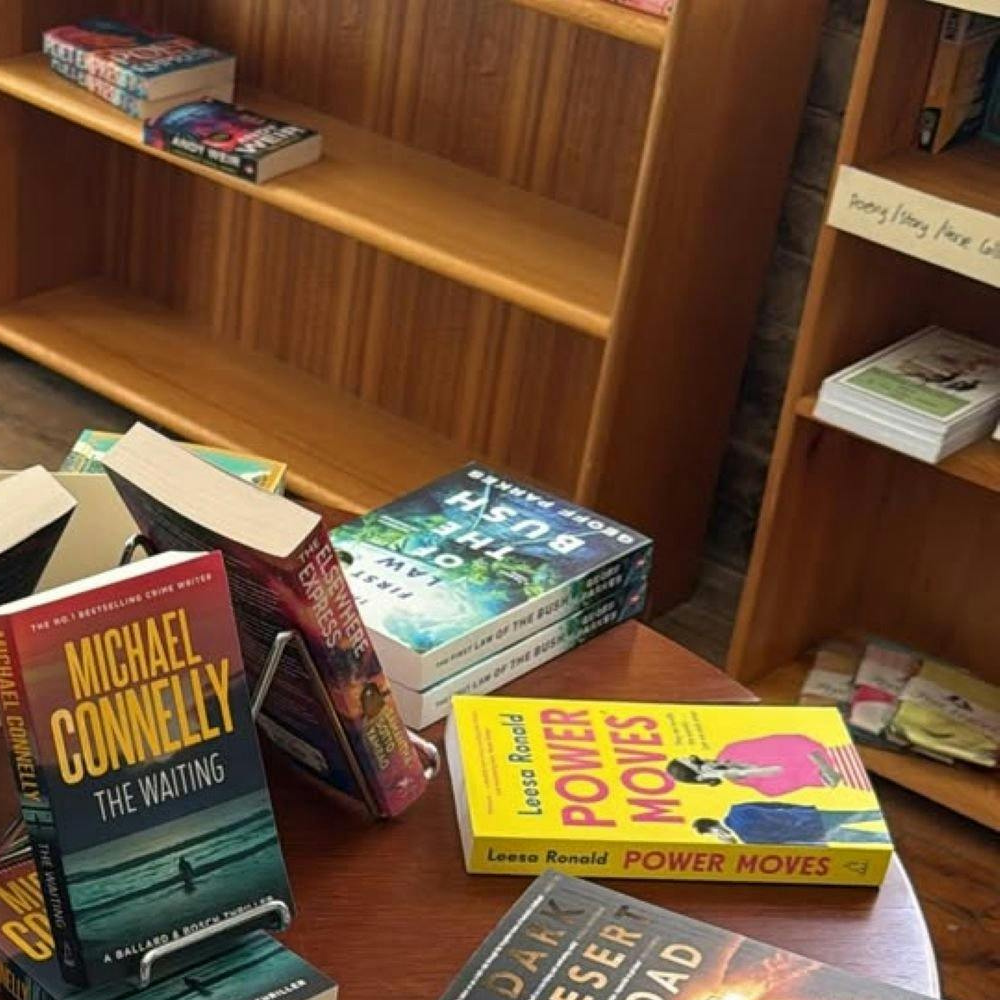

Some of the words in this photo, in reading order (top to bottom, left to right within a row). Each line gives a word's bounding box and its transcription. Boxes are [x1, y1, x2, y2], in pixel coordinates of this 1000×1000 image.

[432, 521, 514, 560] THE
[445, 489, 586, 554] BUSH
[563, 508, 635, 545] GEOFF
[352, 569, 413, 600] FIRST
[377, 556, 441, 588] LAW
[412, 546, 463, 568] OF
[30, 621, 50, 633] THE
[78, 593, 143, 620] BESTSELLING
[145, 585, 175, 601] CRIME
[176, 572, 213, 592] WRITER
[300, 562, 342, 648] EXPRESS
[316, 544, 369, 658] ELSEWHERE
[63, 608, 202, 699] MICHAEL
[474, 634, 494, 650] LAW
[495, 625, 509, 640] OF
[512, 612, 535, 631] THE
[510, 650, 532, 669] THE
[50, 658, 236, 785] CONNELLY
[500, 712, 531, 764] Ronald
[7, 715, 41, 803] CONNELLY
[93, 787, 138, 822] THE
[139, 752, 227, 807] WAITING
[540, 708, 617, 828] POWER
[607, 714, 686, 824] MOVES
[518, 768, 544, 816] Leesa
[37, 842, 51, 869] THE
[488, 847, 539, 865] Leesa
[545, 848, 608, 867] Ronald
[623, 850, 725, 874] POWER
[736, 853, 831, 876] MOVES
[43, 870, 68, 930] WAITING
[104, 953, 113, 964] A
[115, 934, 169, 960] BALLARD
[486, 898, 587, 1000] DARK
